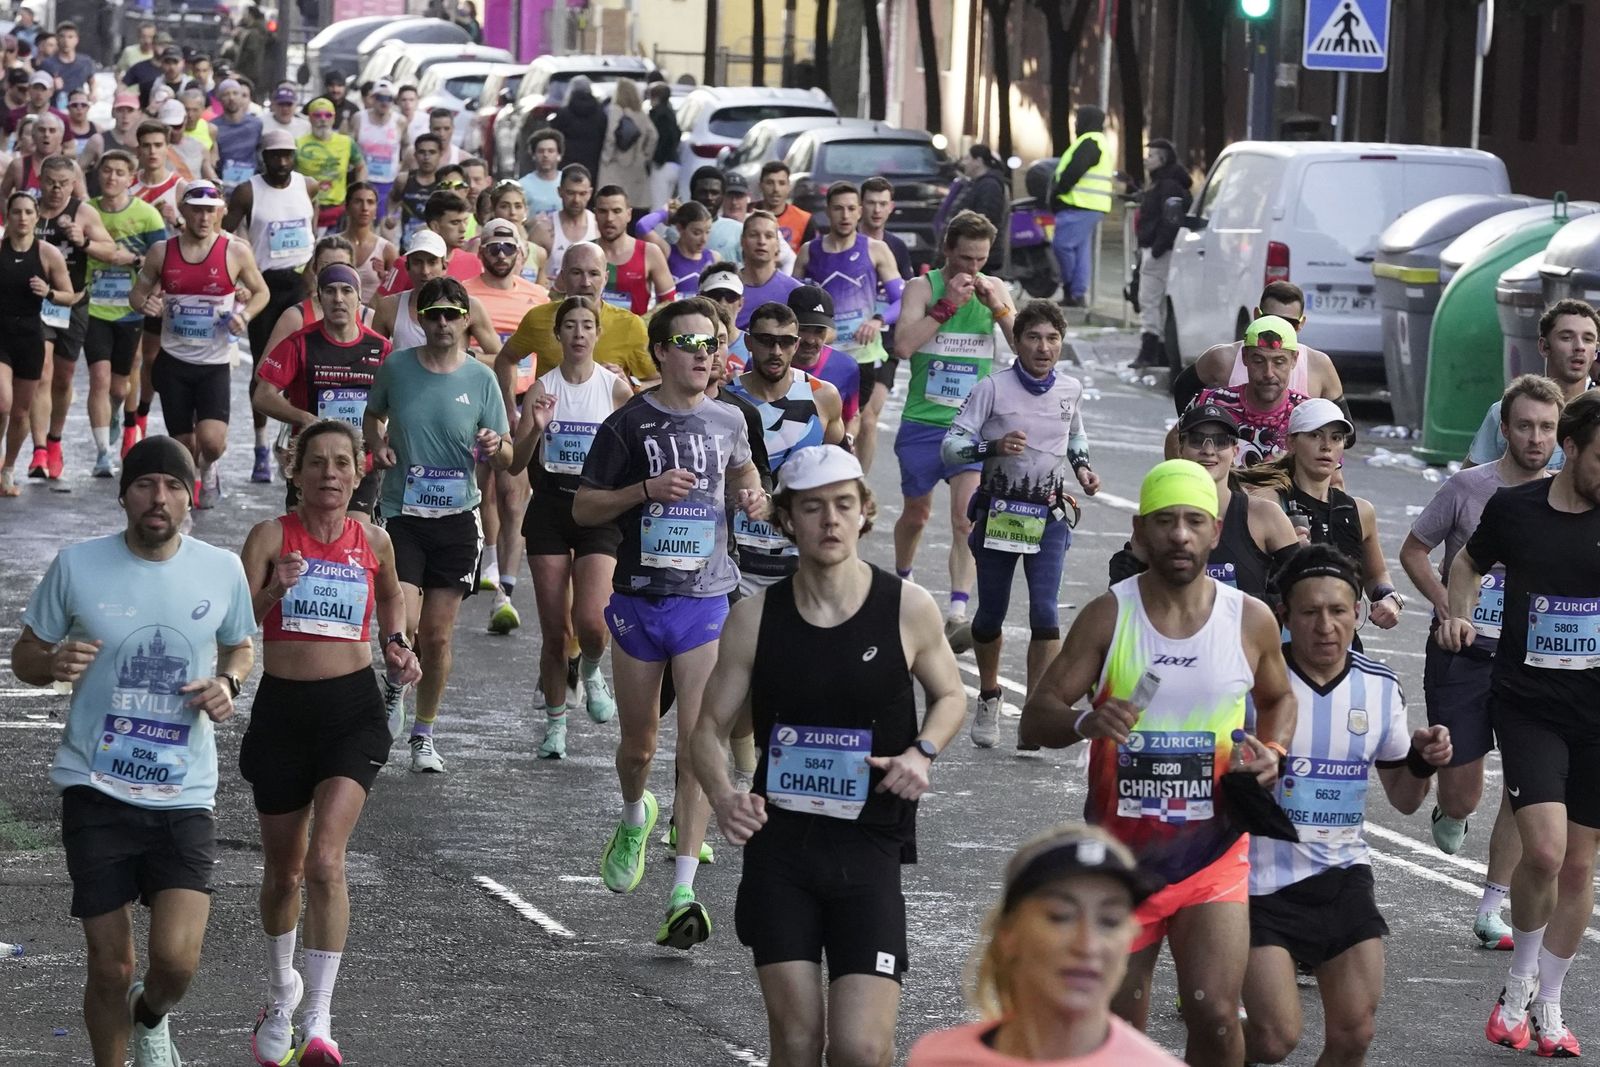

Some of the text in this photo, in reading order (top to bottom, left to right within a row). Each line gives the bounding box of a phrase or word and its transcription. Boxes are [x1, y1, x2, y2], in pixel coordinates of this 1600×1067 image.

[935, 335, 984, 347] Compton
[944, 345, 977, 353] Harriers
[946, 364, 974, 372] ZURICH
[337, 391, 368, 399] ZURICH
[941, 385, 961, 396] PHIL
[563, 424, 597, 434] ZURICH
[560, 450, 587, 462] BEGO
[428, 469, 461, 478] ZURICH
[416, 493, 453, 506] JORGE
[668, 506, 707, 517] ZURICH
[1009, 504, 1041, 515] ZURICH
[668, 526, 689, 536] 7477
[986, 529, 1008, 540] JUAN
[654, 539, 700, 554] JAUME
[314, 564, 358, 579] ZURICH
[313, 585, 338, 598] 6203
[294, 600, 353, 620] MAGALI
[1554, 601, 1598, 612] ZURICH
[1554, 623, 1579, 633] 5803
[1535, 636, 1597, 652] PABLITO
[137, 723, 181, 740] ZURICH
[804, 732, 860, 747] ZURICH
[1150, 736, 1204, 748] ZURICH
[804, 757, 834, 770] 5847
[1152, 762, 1181, 775] 5020
[1316, 763, 1362, 776] ZURICH
[111, 758, 170, 783] NACHO
[780, 772, 857, 797] CHARLIE
[1119, 779, 1212, 799] CHRISTIAN
[1315, 788, 1341, 800] 6632
[1312, 811, 1363, 825] MARTINEZ
